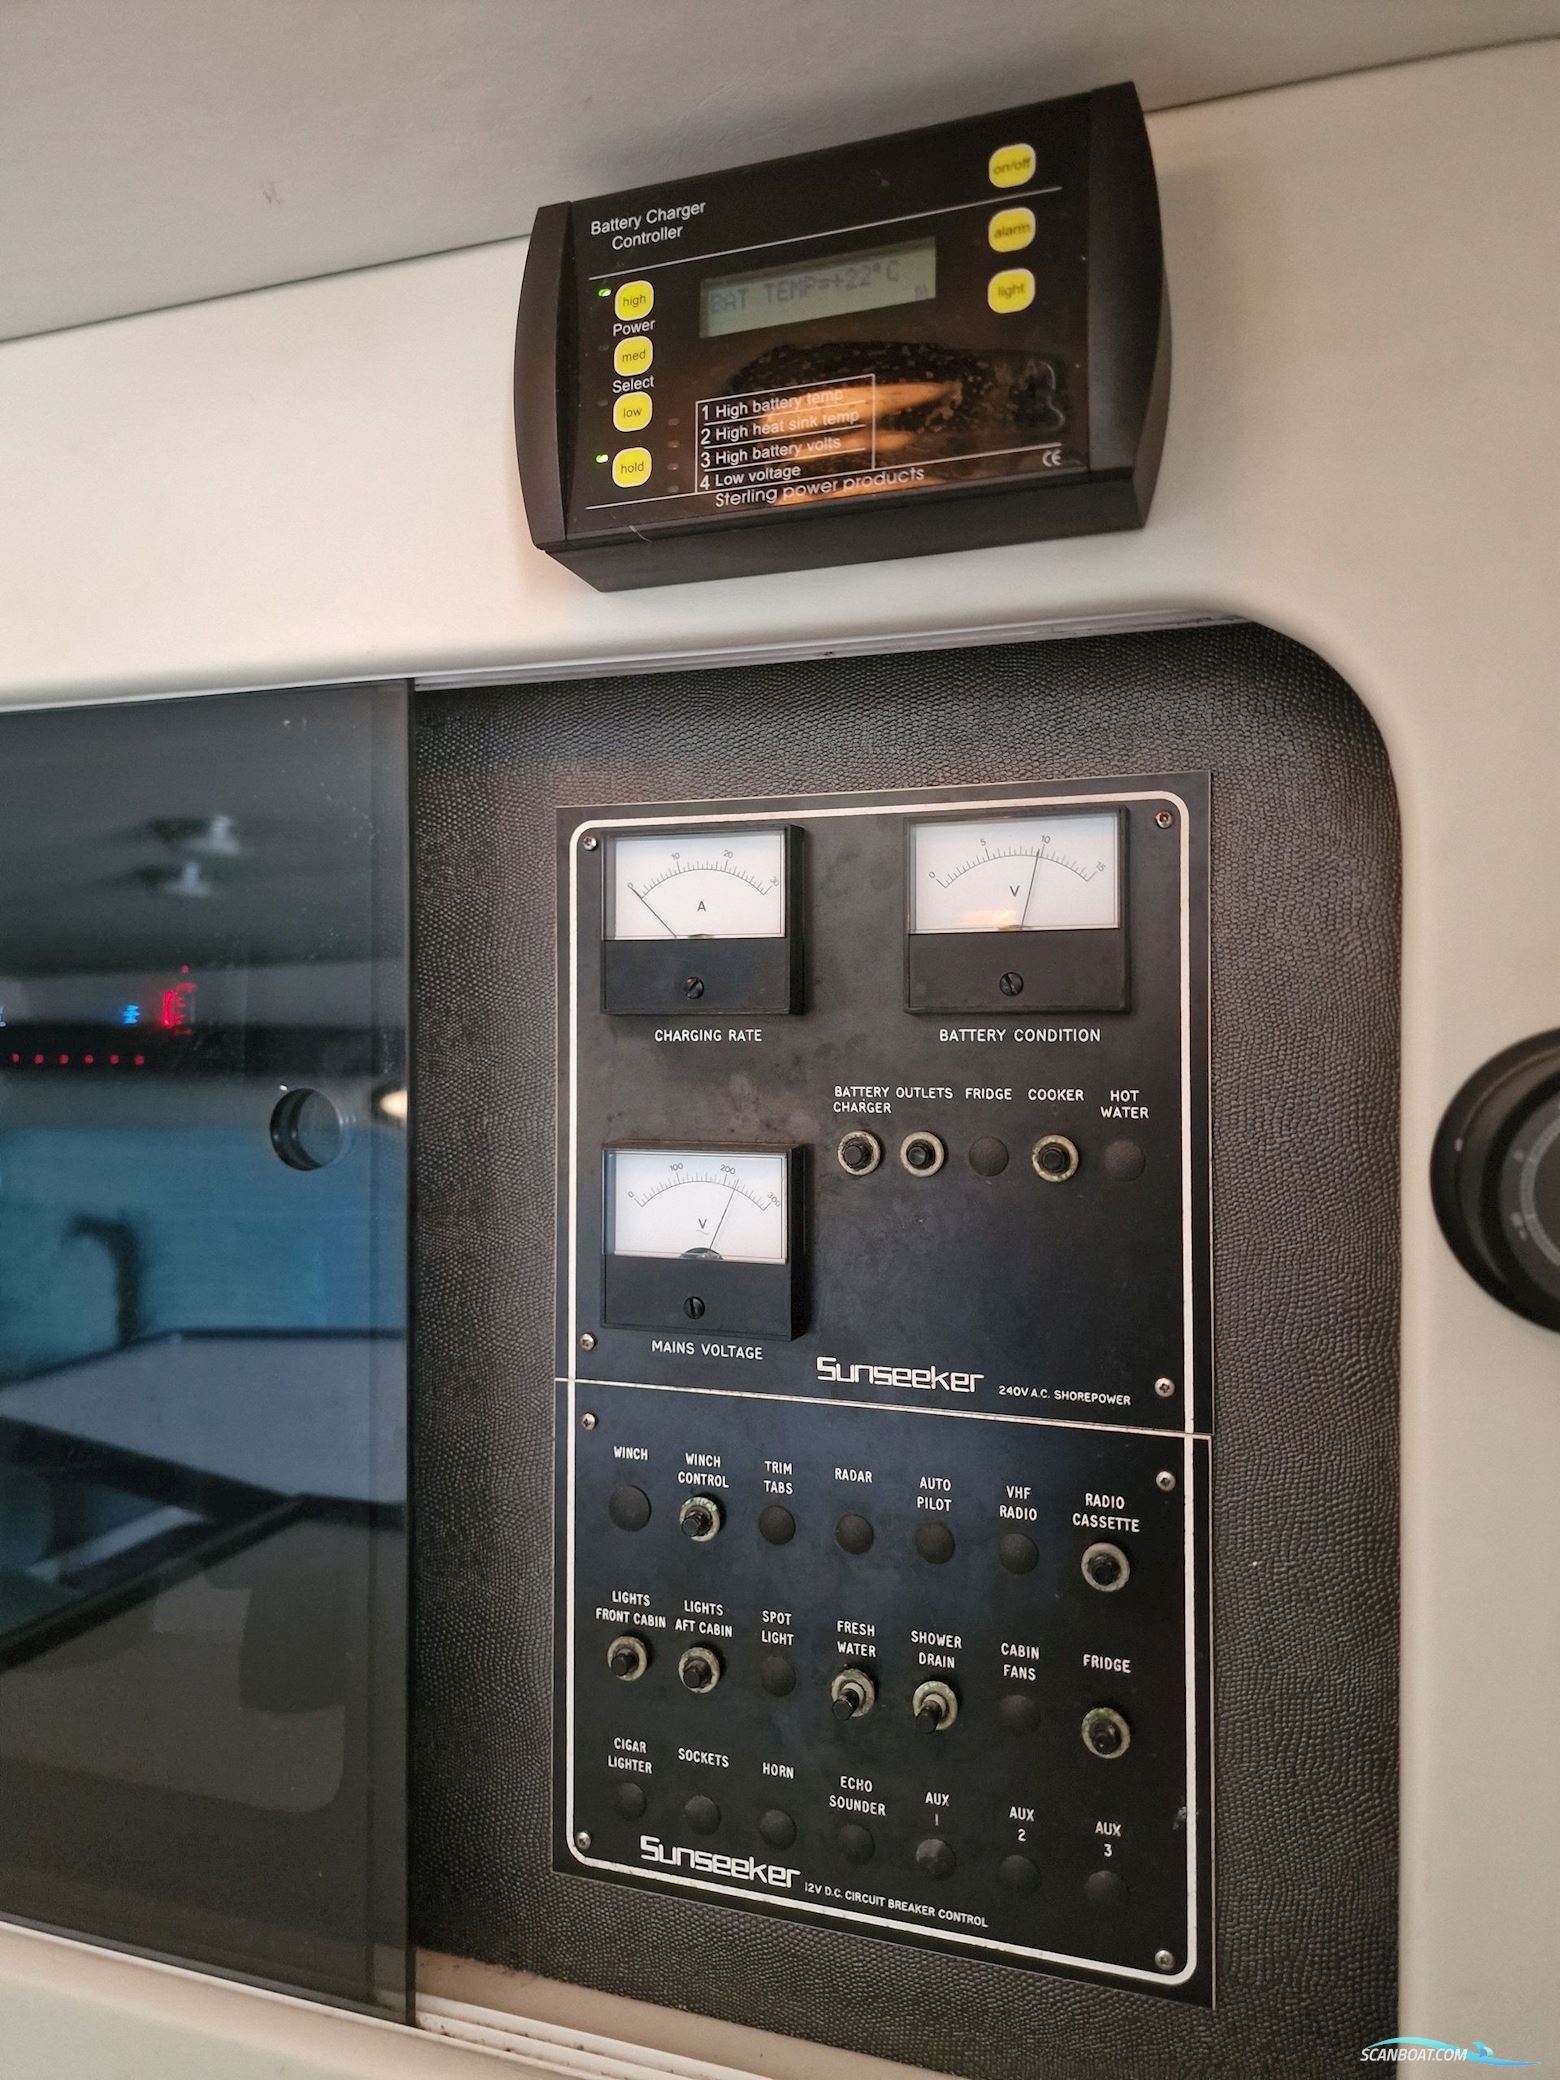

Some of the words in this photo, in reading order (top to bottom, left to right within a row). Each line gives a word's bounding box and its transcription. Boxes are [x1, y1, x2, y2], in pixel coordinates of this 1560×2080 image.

[993, 157, 1031, 175] on/off
[590, 214, 642, 236] Battery
[646, 202, 706, 225] Charger
[611, 224, 683, 250] Controller
[994, 223, 1031, 239] alarm
[997, 282, 1025, 299] light
[622, 294, 647, 309] high
[710, 287, 750, 315] BAT
[612, 318, 656, 337] Power
[622, 349, 646, 363] med
[612, 375, 655, 394] Select
[701, 405, 710, 421] 1
[715, 402, 749, 421] High
[752, 394, 802, 416] battery
[805, 387, 844, 408] temp
[622, 406, 643, 419] low
[700, 428, 711, 445] 2
[715, 424, 749, 444] High
[752, 420, 785, 437] heat
[788, 414, 819, 431] sink
[822, 409, 861, 428] temp
[700, 452, 711, 469] 3
[715, 449, 749, 468] High
[752, 442, 802, 464] battery
[806, 434, 842, 453] volts
[620, 460, 645, 474] hold
[699, 475, 711, 491] 4
[715, 471, 746, 487] Low
[748, 464, 801, 486] voltage
[715, 485, 778, 508] Sterling
[782, 478, 839, 504] power
[842, 465, 926, 492] products
[1041, 834, 1051, 844] 10
[671, 852, 681, 860] 10
[723, 849, 733, 859] 20
[1096, 861, 1106, 872] 15
[769, 876, 780, 887] 30
[1009, 885, 1020, 897] V
[697, 901, 706, 912] A
[654, 1029, 722, 1042] CHARGING
[728, 1030, 762, 1042] RATE
[939, 1028, 1006, 1042] BATTERY
[1013, 1028, 1101, 1042] CONDITION
[834, 1086, 889, 1098] BATTERY
[895, 1086, 953, 1100] OUTLETS
[965, 1087, 1012, 1100] FRIDGE
[1028, 1088, 1084, 1101] COOKER
[1110, 1089, 1140, 1103] HOT
[833, 1101, 892, 1114] CHARGER
[1100, 1106, 1149, 1119] WATER
[669, 1162, 684, 1172] 100
[720, 1164, 736, 1175] 200
[767, 1191, 781, 1208] 300
[698, 1218, 707, 1229] V
[651, 1340, 695, 1355] MAINS
[701, 1343, 763, 1360] VOLTAGE
[816, 1355, 984, 1393] Sunseeker
[999, 1385, 1029, 1397] 240V
[1053, 1389, 1131, 1406] SHOREPOWER
[613, 1446, 648, 1461] WINCH
[685, 1452, 721, 1468] WINCH
[764, 1460, 793, 1475] TRIM
[834, 1467, 873, 1483] RADAR
[677, 1471, 729, 1488] CONTROL
[763, 1480, 793, 1495] TABS
[919, 1476, 951, 1491] AUTO
[1006, 1485, 1032, 1500] VHF
[916, 1496, 952, 1512] PILOT
[1085, 1493, 1125, 1510] RADIO
[999, 1504, 1038, 1521] RADIO
[1072, 1513, 1140, 1533] CASSETTE
[611, 1590, 650, 1606] LIGHTS
[684, 1600, 724, 1616] LIGHTS
[595, 1607, 630, 1624] FRONT
[633, 1612, 666, 1628] CABIN
[762, 1610, 792, 1626] SPOT
[674, 1618, 696, 1633] AFT
[698, 1622, 733, 1638] CABIN
[837, 1620, 875, 1637] FRESH
[761, 1630, 794, 1646] LIGHT
[910, 1630, 963, 1649] SHOWER
[837, 1641, 877, 1658] WATER
[1000, 1642, 1040, 1660] CABIN
[918, 1652, 955, 1669] DRAIN
[1083, 1653, 1132, 1674] FRIDGE
[1003, 1663, 1037, 1681] FANS
[613, 1737, 647, 1754] CIGAR
[607, 1755, 653, 1774] LIGHTER
[677, 1747, 730, 1768] SOCKETS
[762, 1762, 795, 1779] HORN
[840, 1775, 873, 1793] ECHO
[829, 1794, 886, 1817] SOUNDER
[925, 1791, 950, 1807] AUX
[1009, 1806, 1035, 1822] AUX
[1017, 1828, 1027, 1843] 2
[1095, 1821, 1122, 1838] AUX
[1103, 1843, 1113, 1858] 3
[640, 1835, 801, 1888] Sunseeker
[804, 1881, 822, 1894] 12V
[845, 1890, 886, 1907] CIRCUIT
[888, 1898, 936, 1917] BREAKER
[938, 1908, 989, 1928] CONTROL
